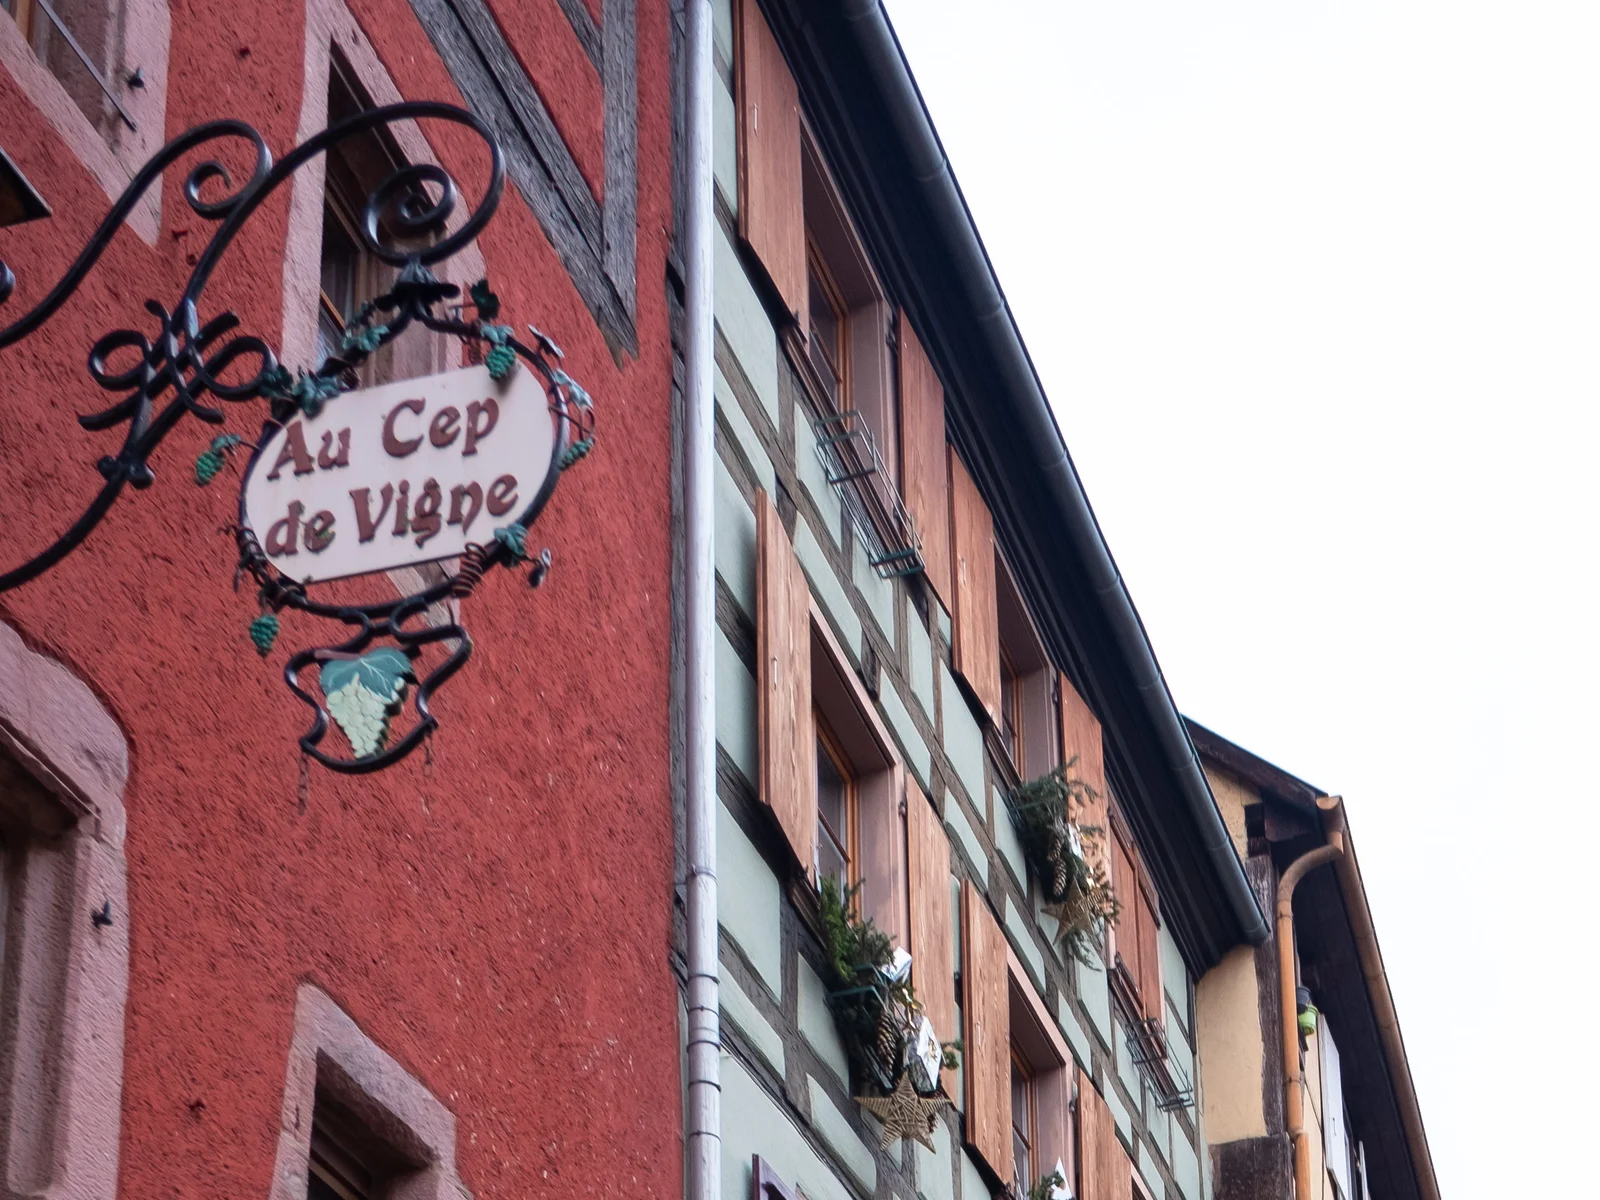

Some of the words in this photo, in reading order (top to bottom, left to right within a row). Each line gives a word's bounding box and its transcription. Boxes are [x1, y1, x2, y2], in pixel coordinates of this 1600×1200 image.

[266, 420, 352, 482] Au
[381, 397, 500, 459] Cep
[265, 500, 337, 558] de
[349, 473, 519, 548] Vigne
